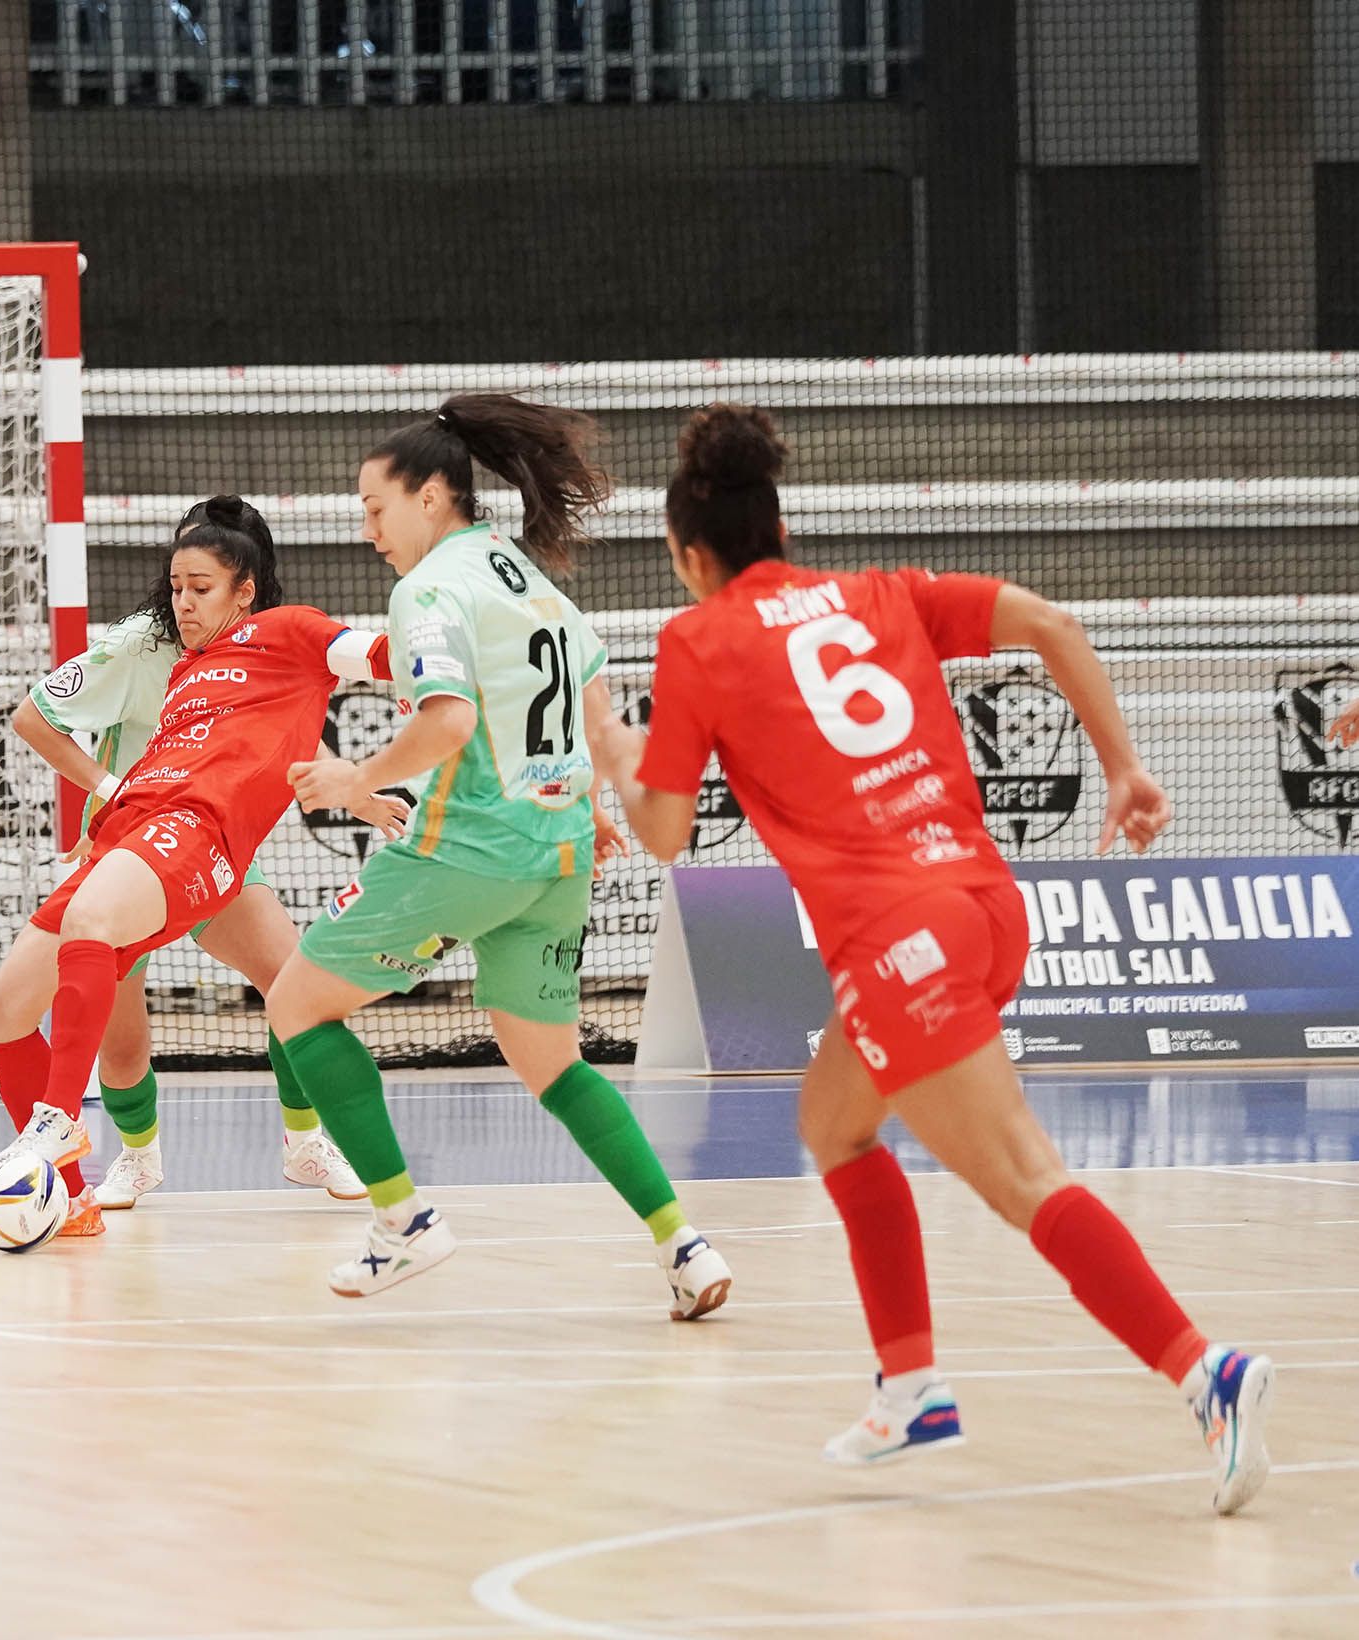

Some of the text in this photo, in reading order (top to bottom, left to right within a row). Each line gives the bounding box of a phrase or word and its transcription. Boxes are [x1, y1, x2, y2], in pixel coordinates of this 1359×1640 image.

[526, 626, 574, 757] 21
[786, 612, 915, 758] 6
[985, 780, 1056, 808] RFGF
[142, 824, 178, 858] 12
[1018, 874, 1353, 945] OPA GALICIA
[1024, 944, 1216, 987] ÚTBOL SALA
[1019, 997, 1107, 1016] MUNICIPAL
[1108, 996, 1132, 1014] DE
[1133, 994, 1249, 1014] PONTEVEDRA
[1170, 1029, 1213, 1041] XUNTA
[1172, 1039, 1241, 1052] DE GALICIA
